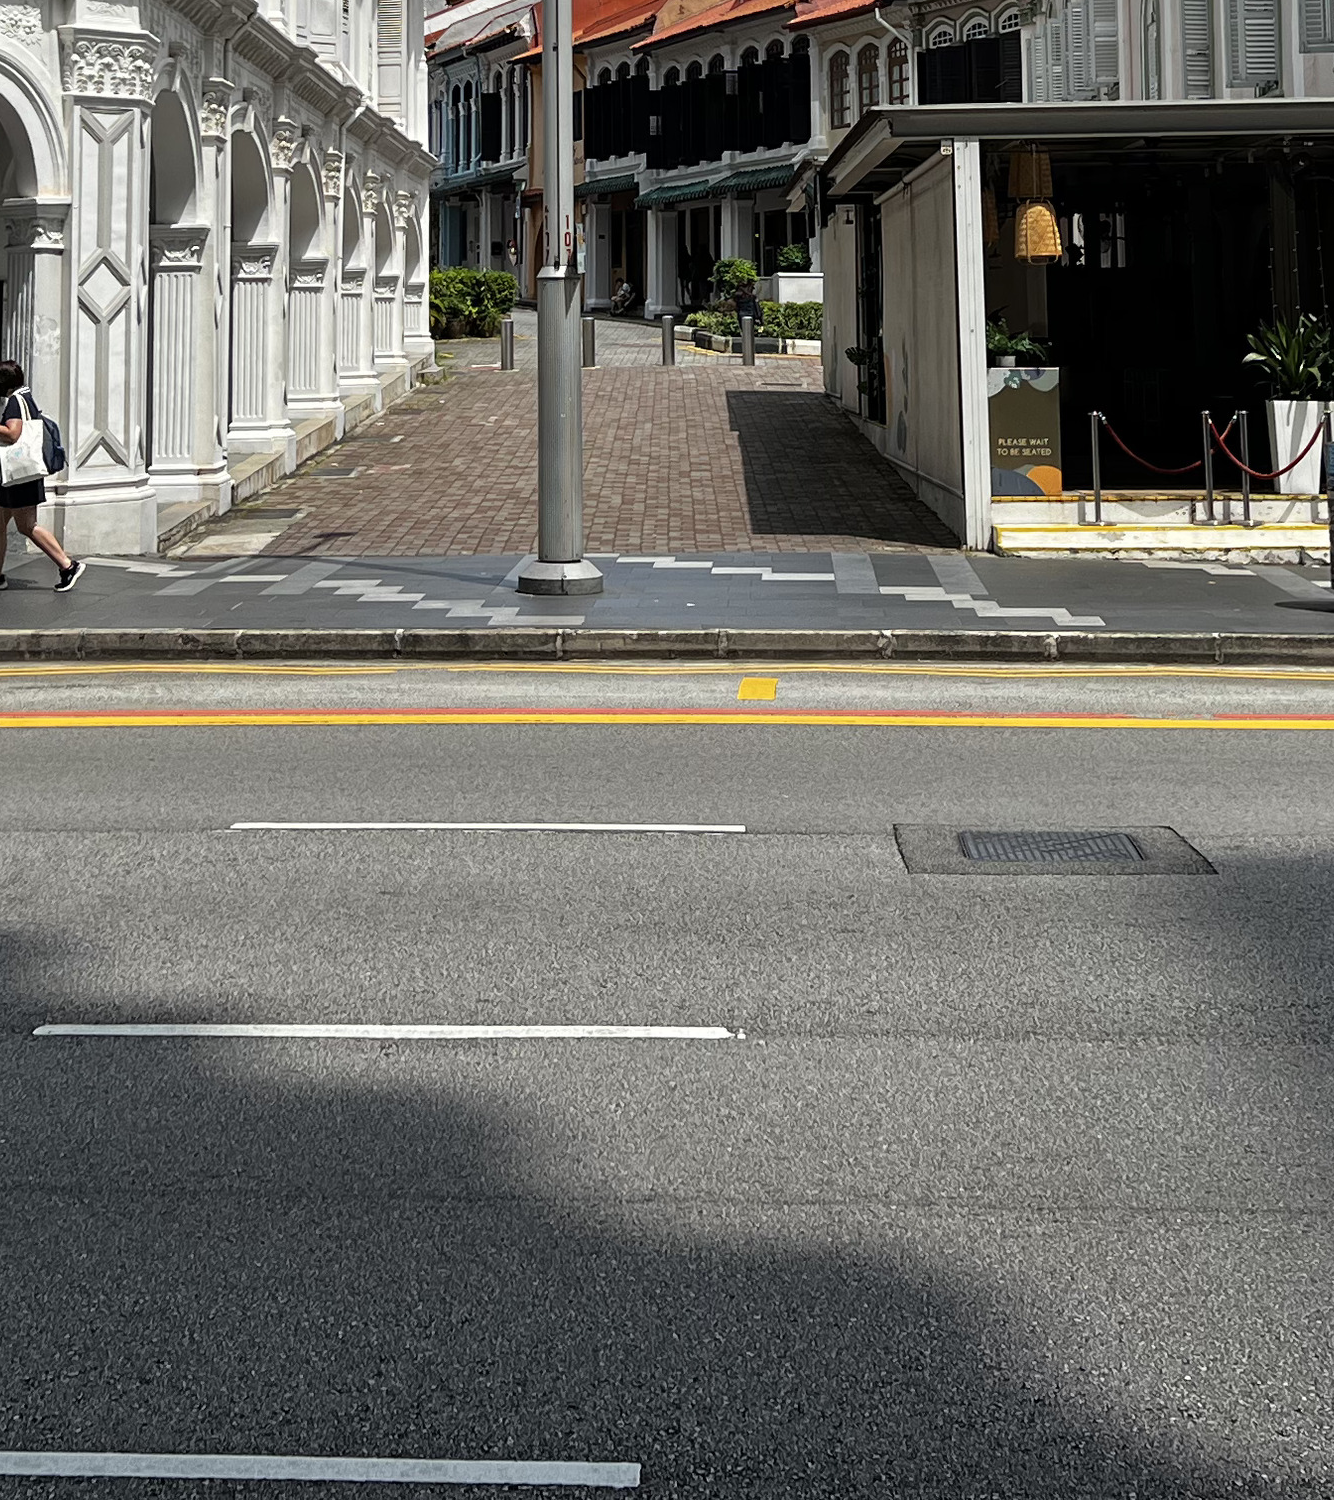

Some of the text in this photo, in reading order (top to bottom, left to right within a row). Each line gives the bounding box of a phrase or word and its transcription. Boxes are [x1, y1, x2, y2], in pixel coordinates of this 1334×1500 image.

[998, 438, 1049, 446] PLEASE WAIT
[997, 448, 1052, 456] TO BE SEATED
